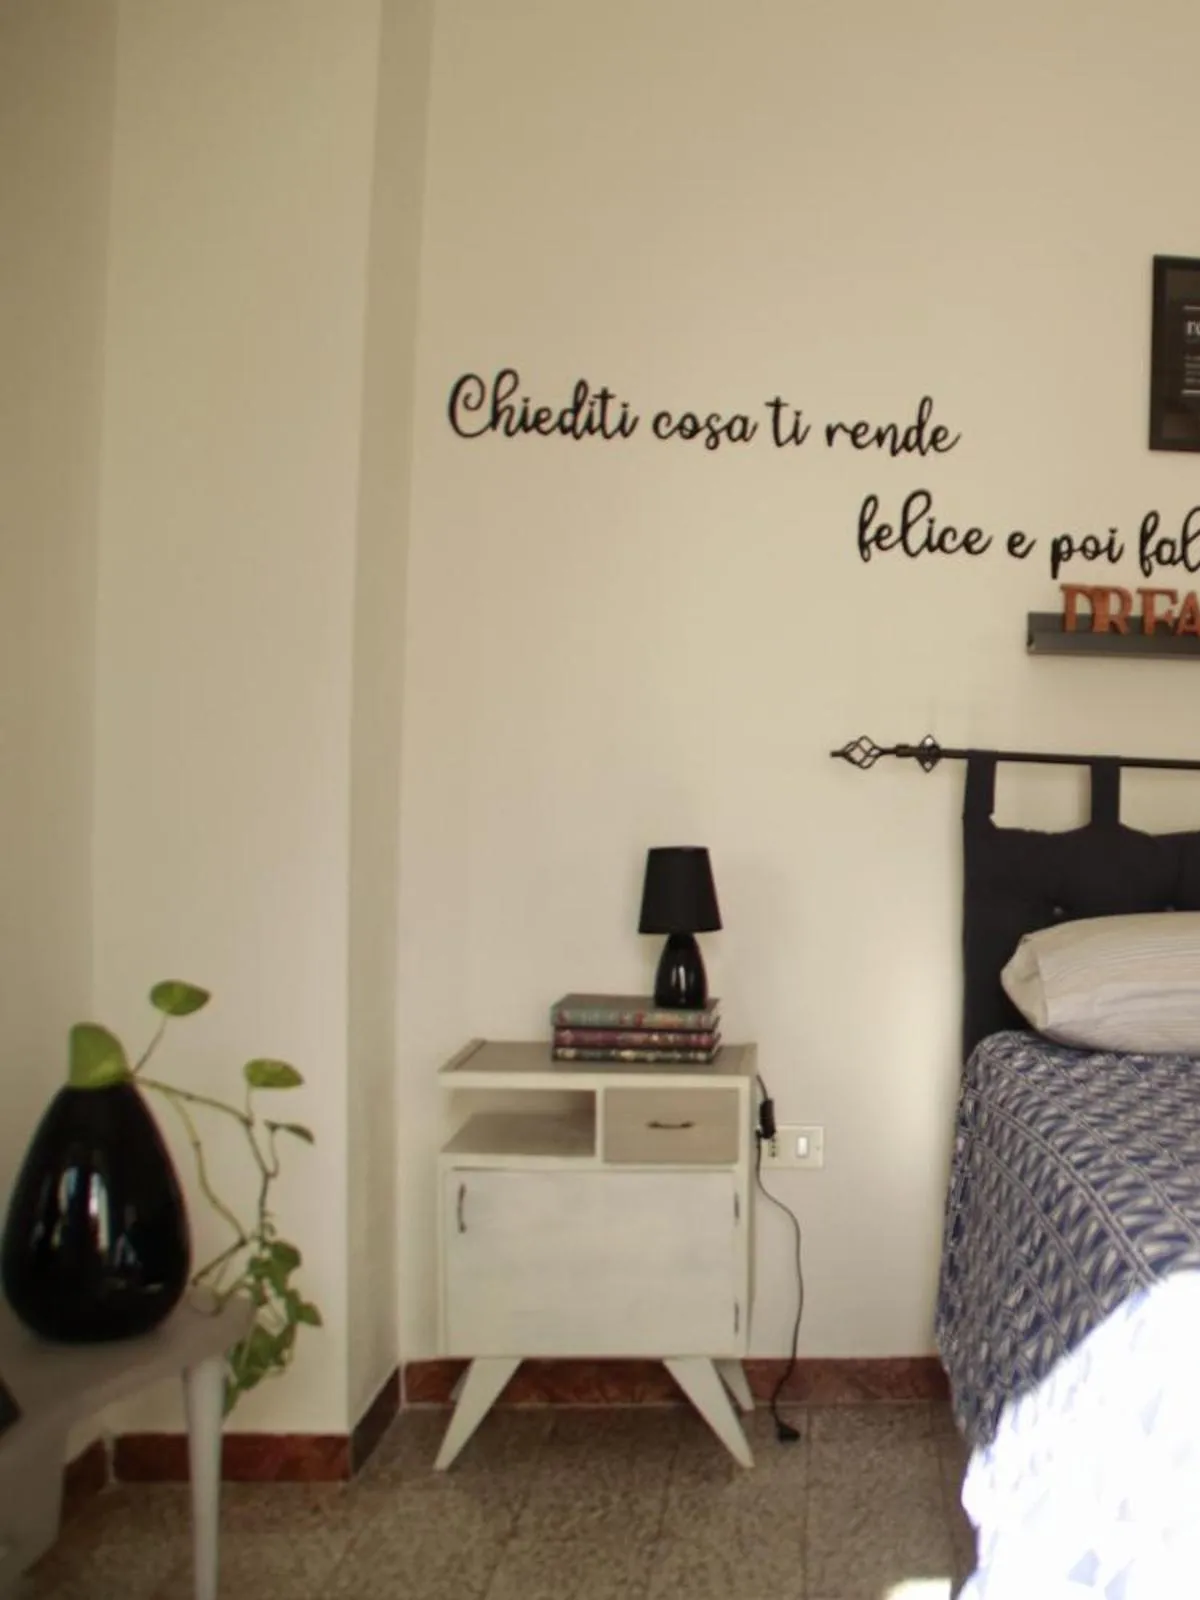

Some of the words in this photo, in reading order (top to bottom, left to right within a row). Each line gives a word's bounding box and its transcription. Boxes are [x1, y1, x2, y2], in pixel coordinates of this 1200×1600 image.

[446, 368, 640, 441] Chiediti
[651, 410, 759, 451] cosa
[764, 396, 811, 448] ti
[825, 396, 961, 457] rende
[857, 488, 993, 563] felice
[1006, 530, 1037, 560] e
[1050, 527, 1125, 580] poi
